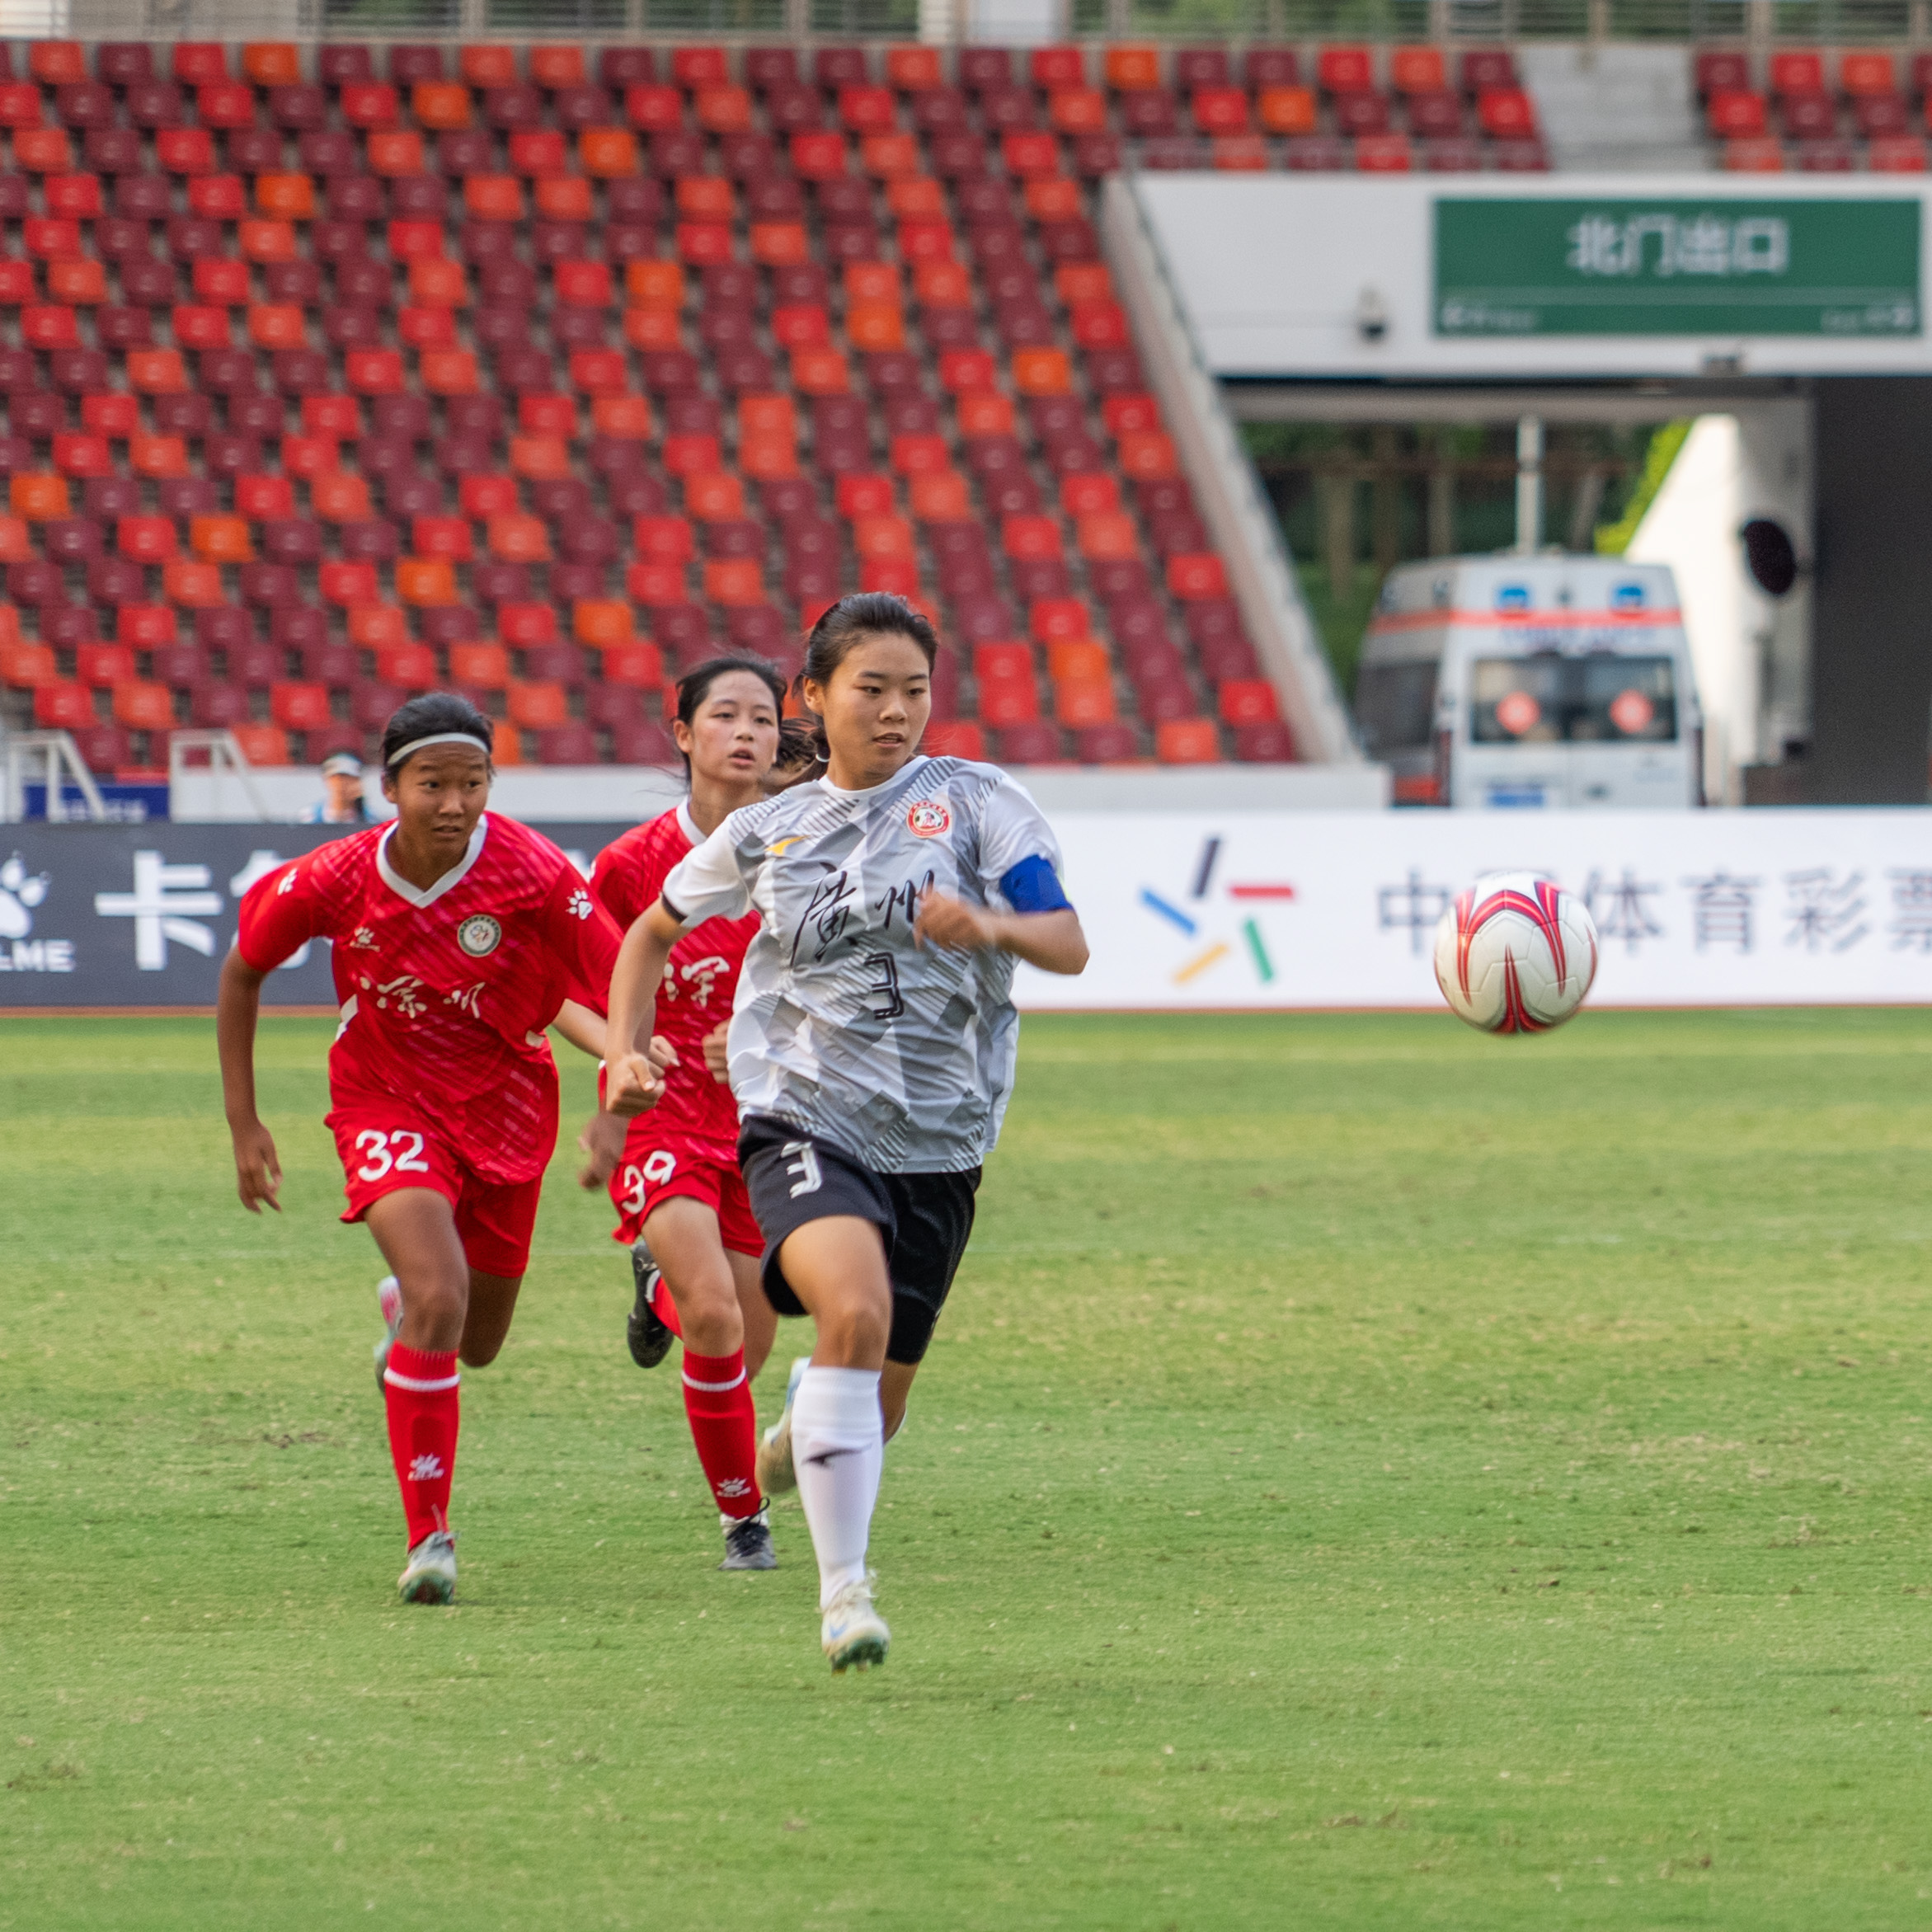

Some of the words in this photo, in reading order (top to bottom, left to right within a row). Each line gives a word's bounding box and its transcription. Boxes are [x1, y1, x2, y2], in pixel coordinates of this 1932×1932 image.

[1570, 213, 1788, 275] 北门出口
[1375, 864, 1932, 957] 中体育彩票
[863, 952, 905, 1020] 3
[355, 1129, 429, 1182] 32
[622, 1149, 676, 1215] 39
[780, 1141, 823, 1200] 3
